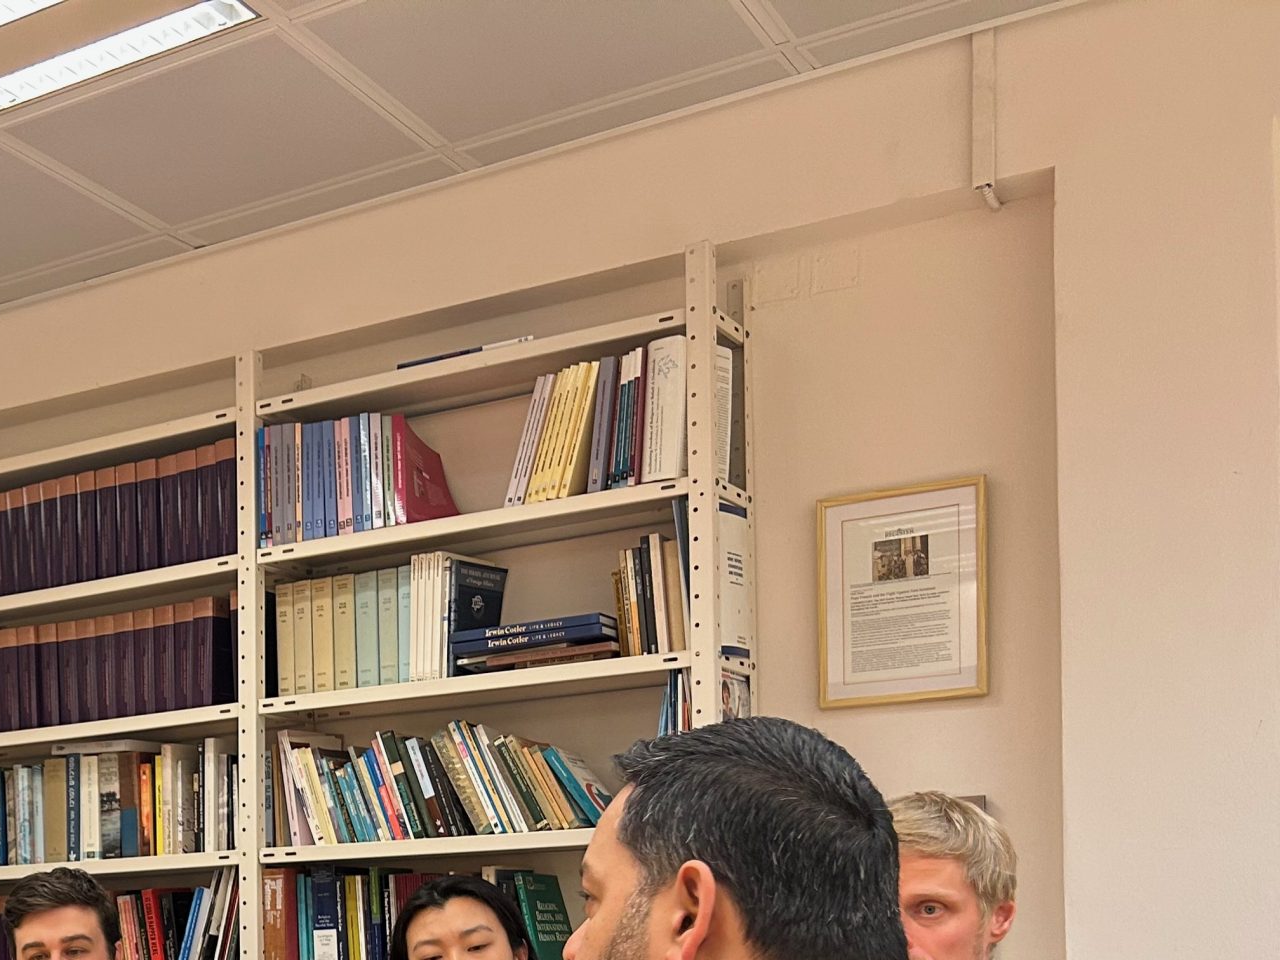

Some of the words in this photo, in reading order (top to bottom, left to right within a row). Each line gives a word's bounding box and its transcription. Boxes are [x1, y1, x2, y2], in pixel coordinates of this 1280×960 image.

[485, 628, 504, 637] Irwin
[505, 625, 527, 634] Cotler
[488, 638, 507, 648] Irwin
[507, 635, 529, 645] Cotler
